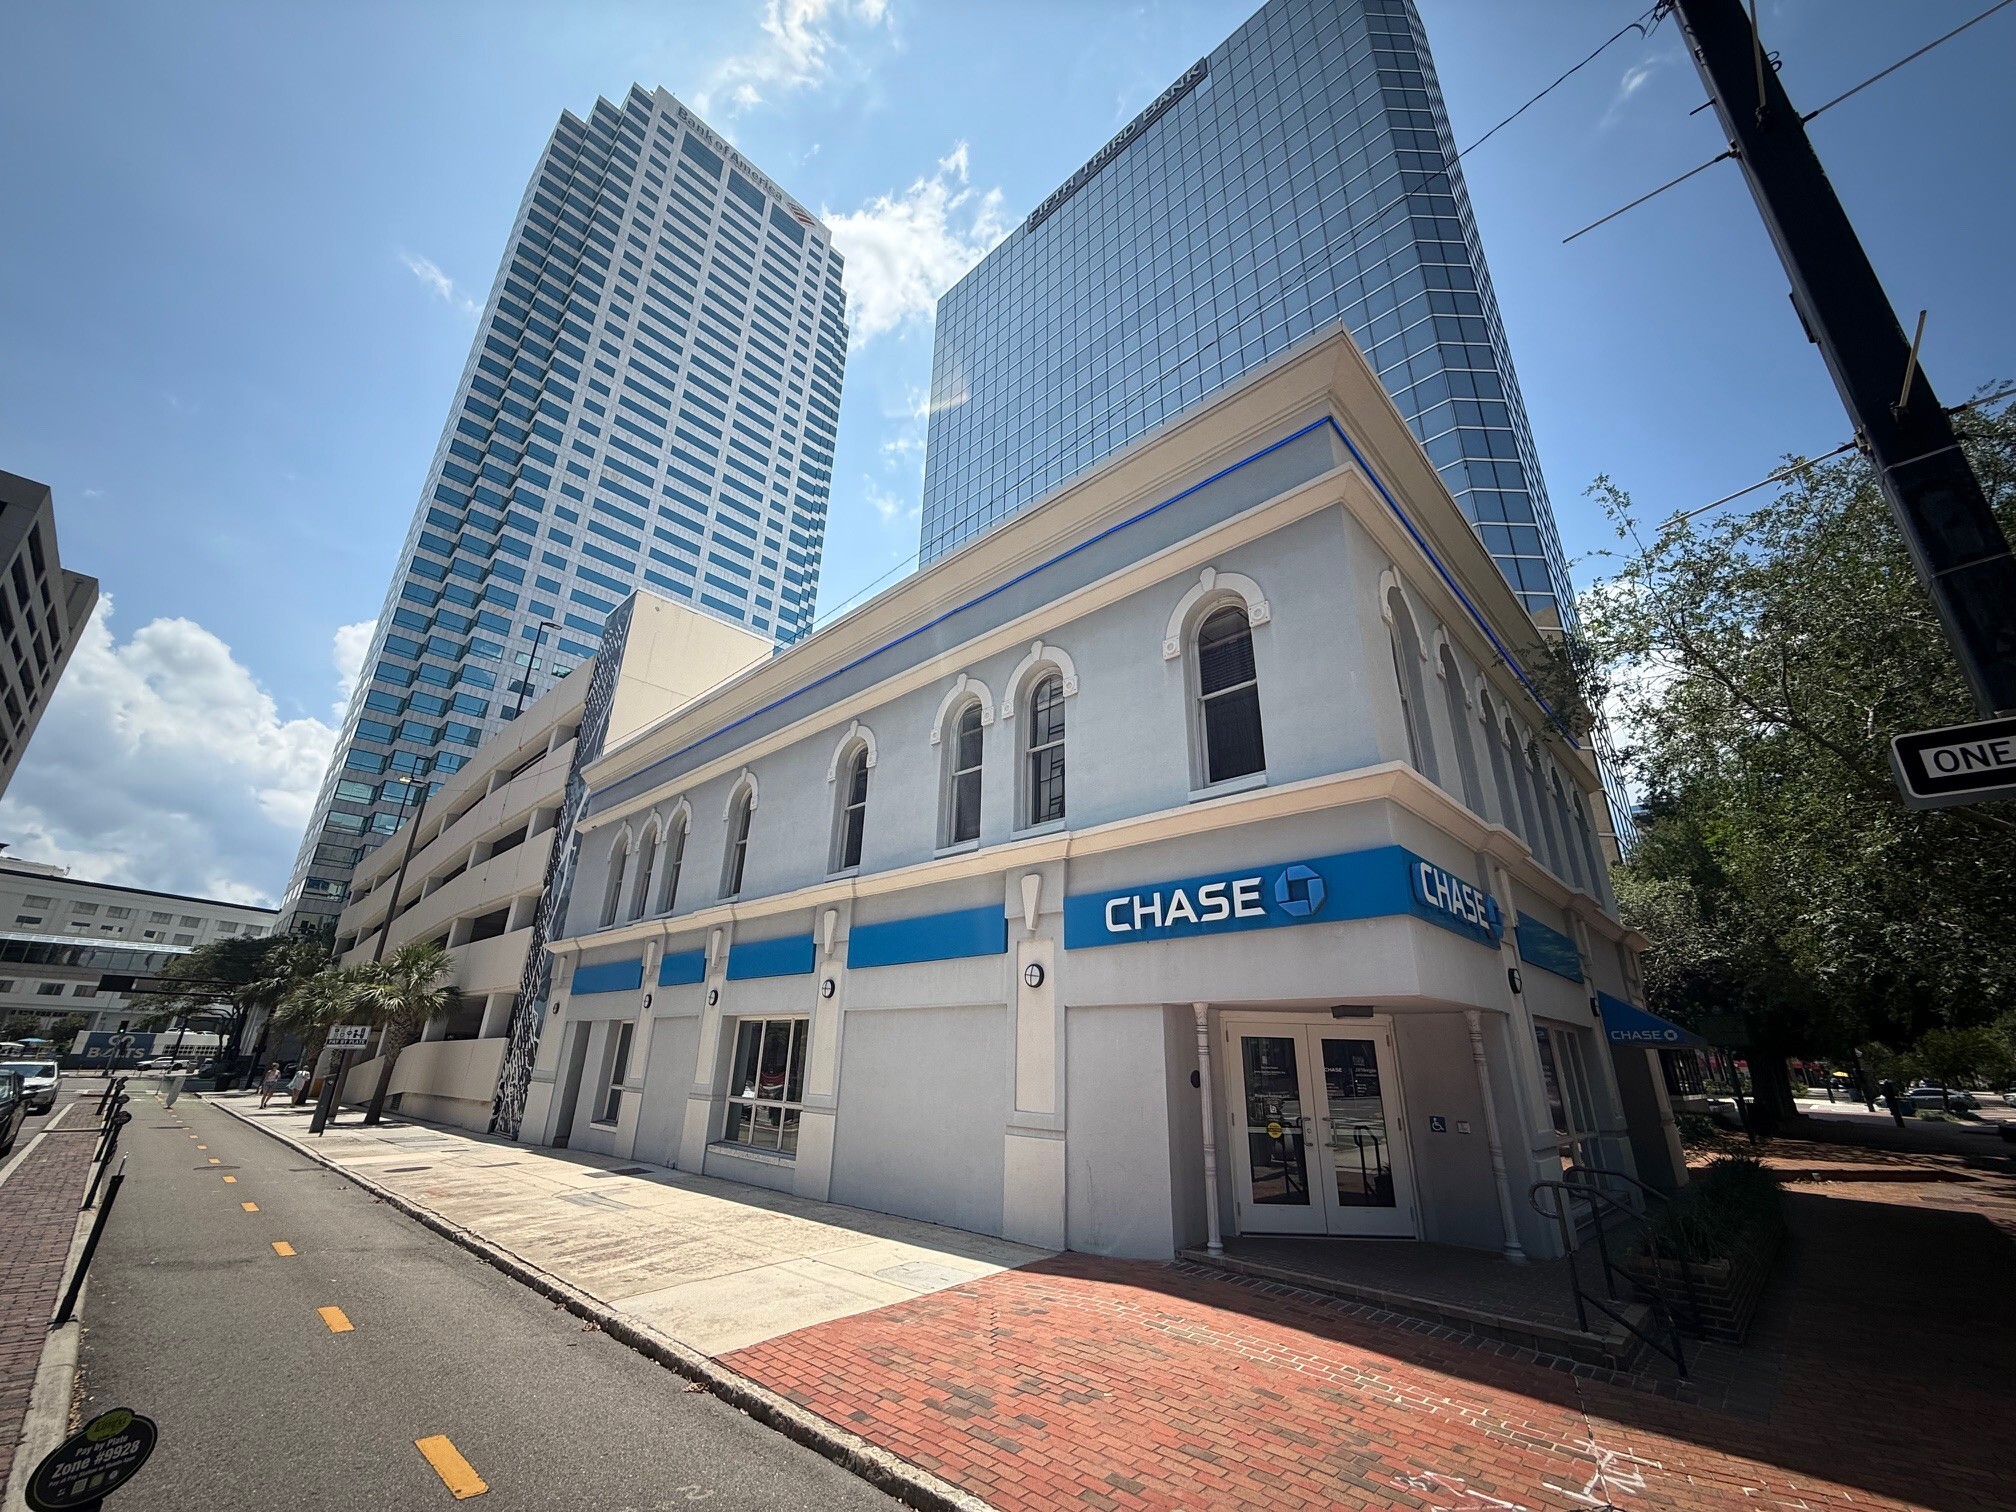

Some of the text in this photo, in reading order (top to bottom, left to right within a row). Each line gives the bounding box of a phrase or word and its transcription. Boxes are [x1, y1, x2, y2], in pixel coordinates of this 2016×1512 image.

[677, 106, 782, 202] Bank of America
[1030, 63, 1201, 224] FIFTH THIRD BANK
[1933, 740, 2016, 773] ONE
[1105, 877, 1267, 933] CHASE
[1419, 862, 1491, 929] CHASE
[1610, 1030, 1663, 1040] CHASE
[51, 1440, 141, 1478] Zone #9928
[75, 1435, 129, 1457] Pay by Plate
